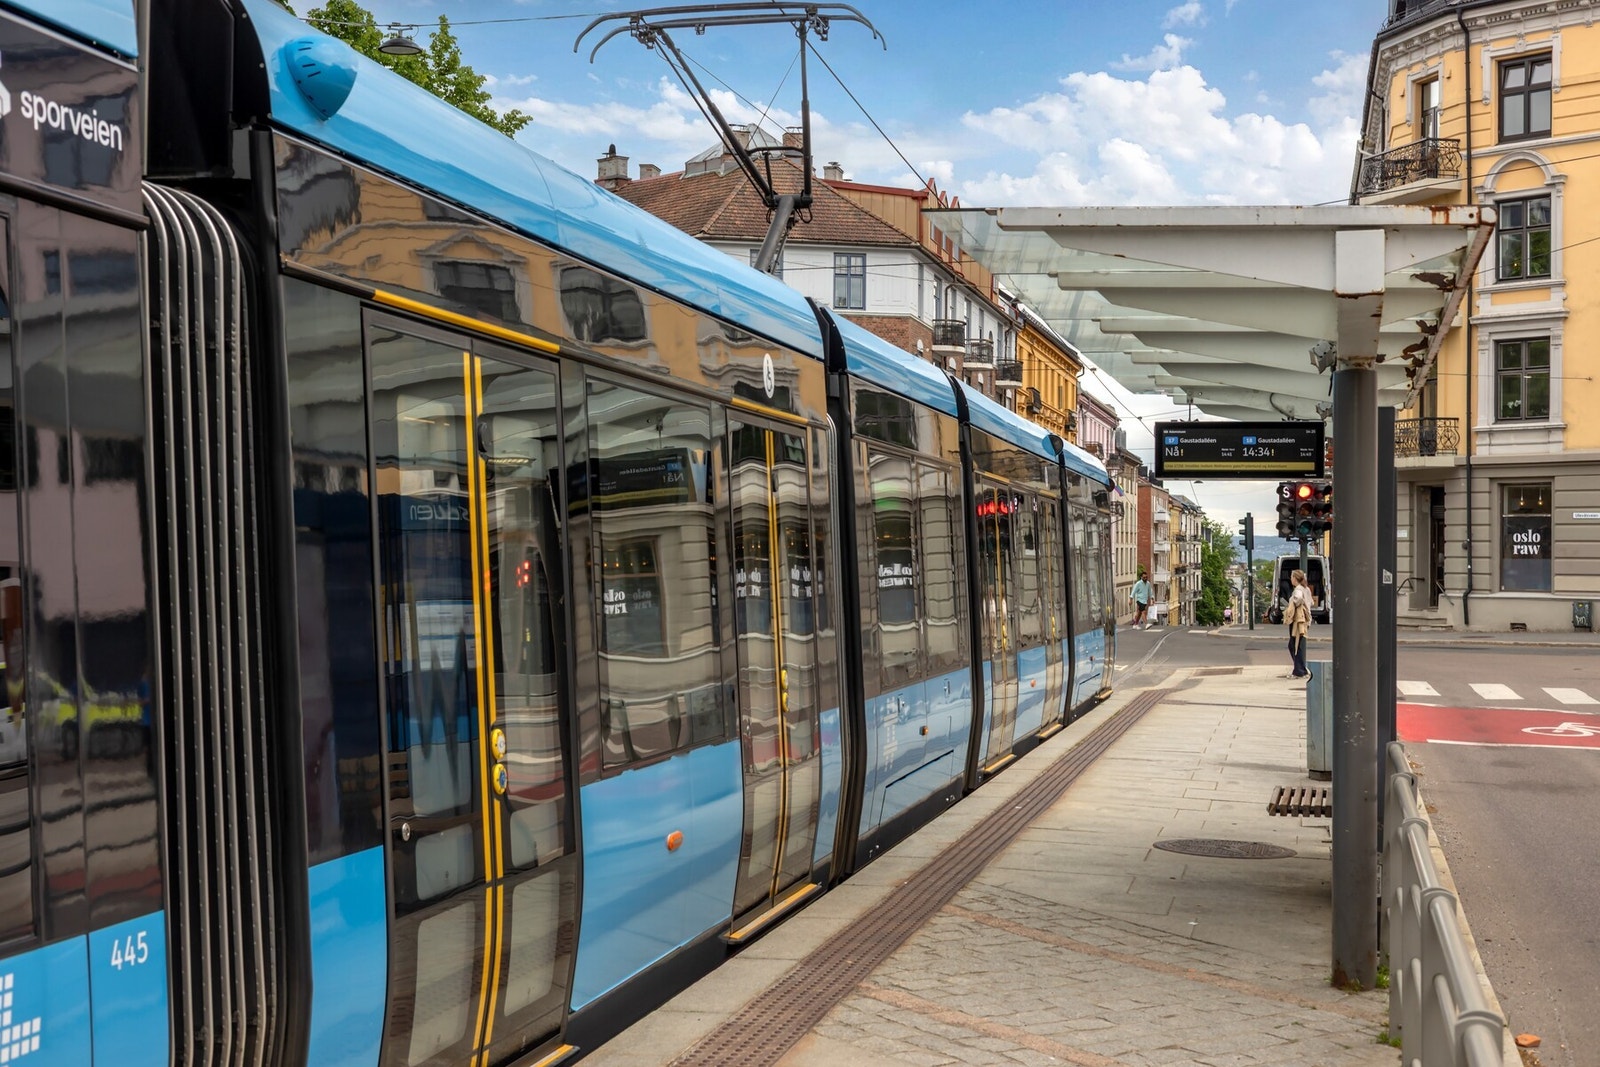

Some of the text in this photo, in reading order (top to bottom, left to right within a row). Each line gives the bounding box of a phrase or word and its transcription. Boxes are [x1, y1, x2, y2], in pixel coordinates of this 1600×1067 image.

[20, 91, 123, 151] sporveien
[1512, 529, 1541, 543] oslo
[1512, 544, 1541, 555] raw
[110, 930, 149, 971] 445
